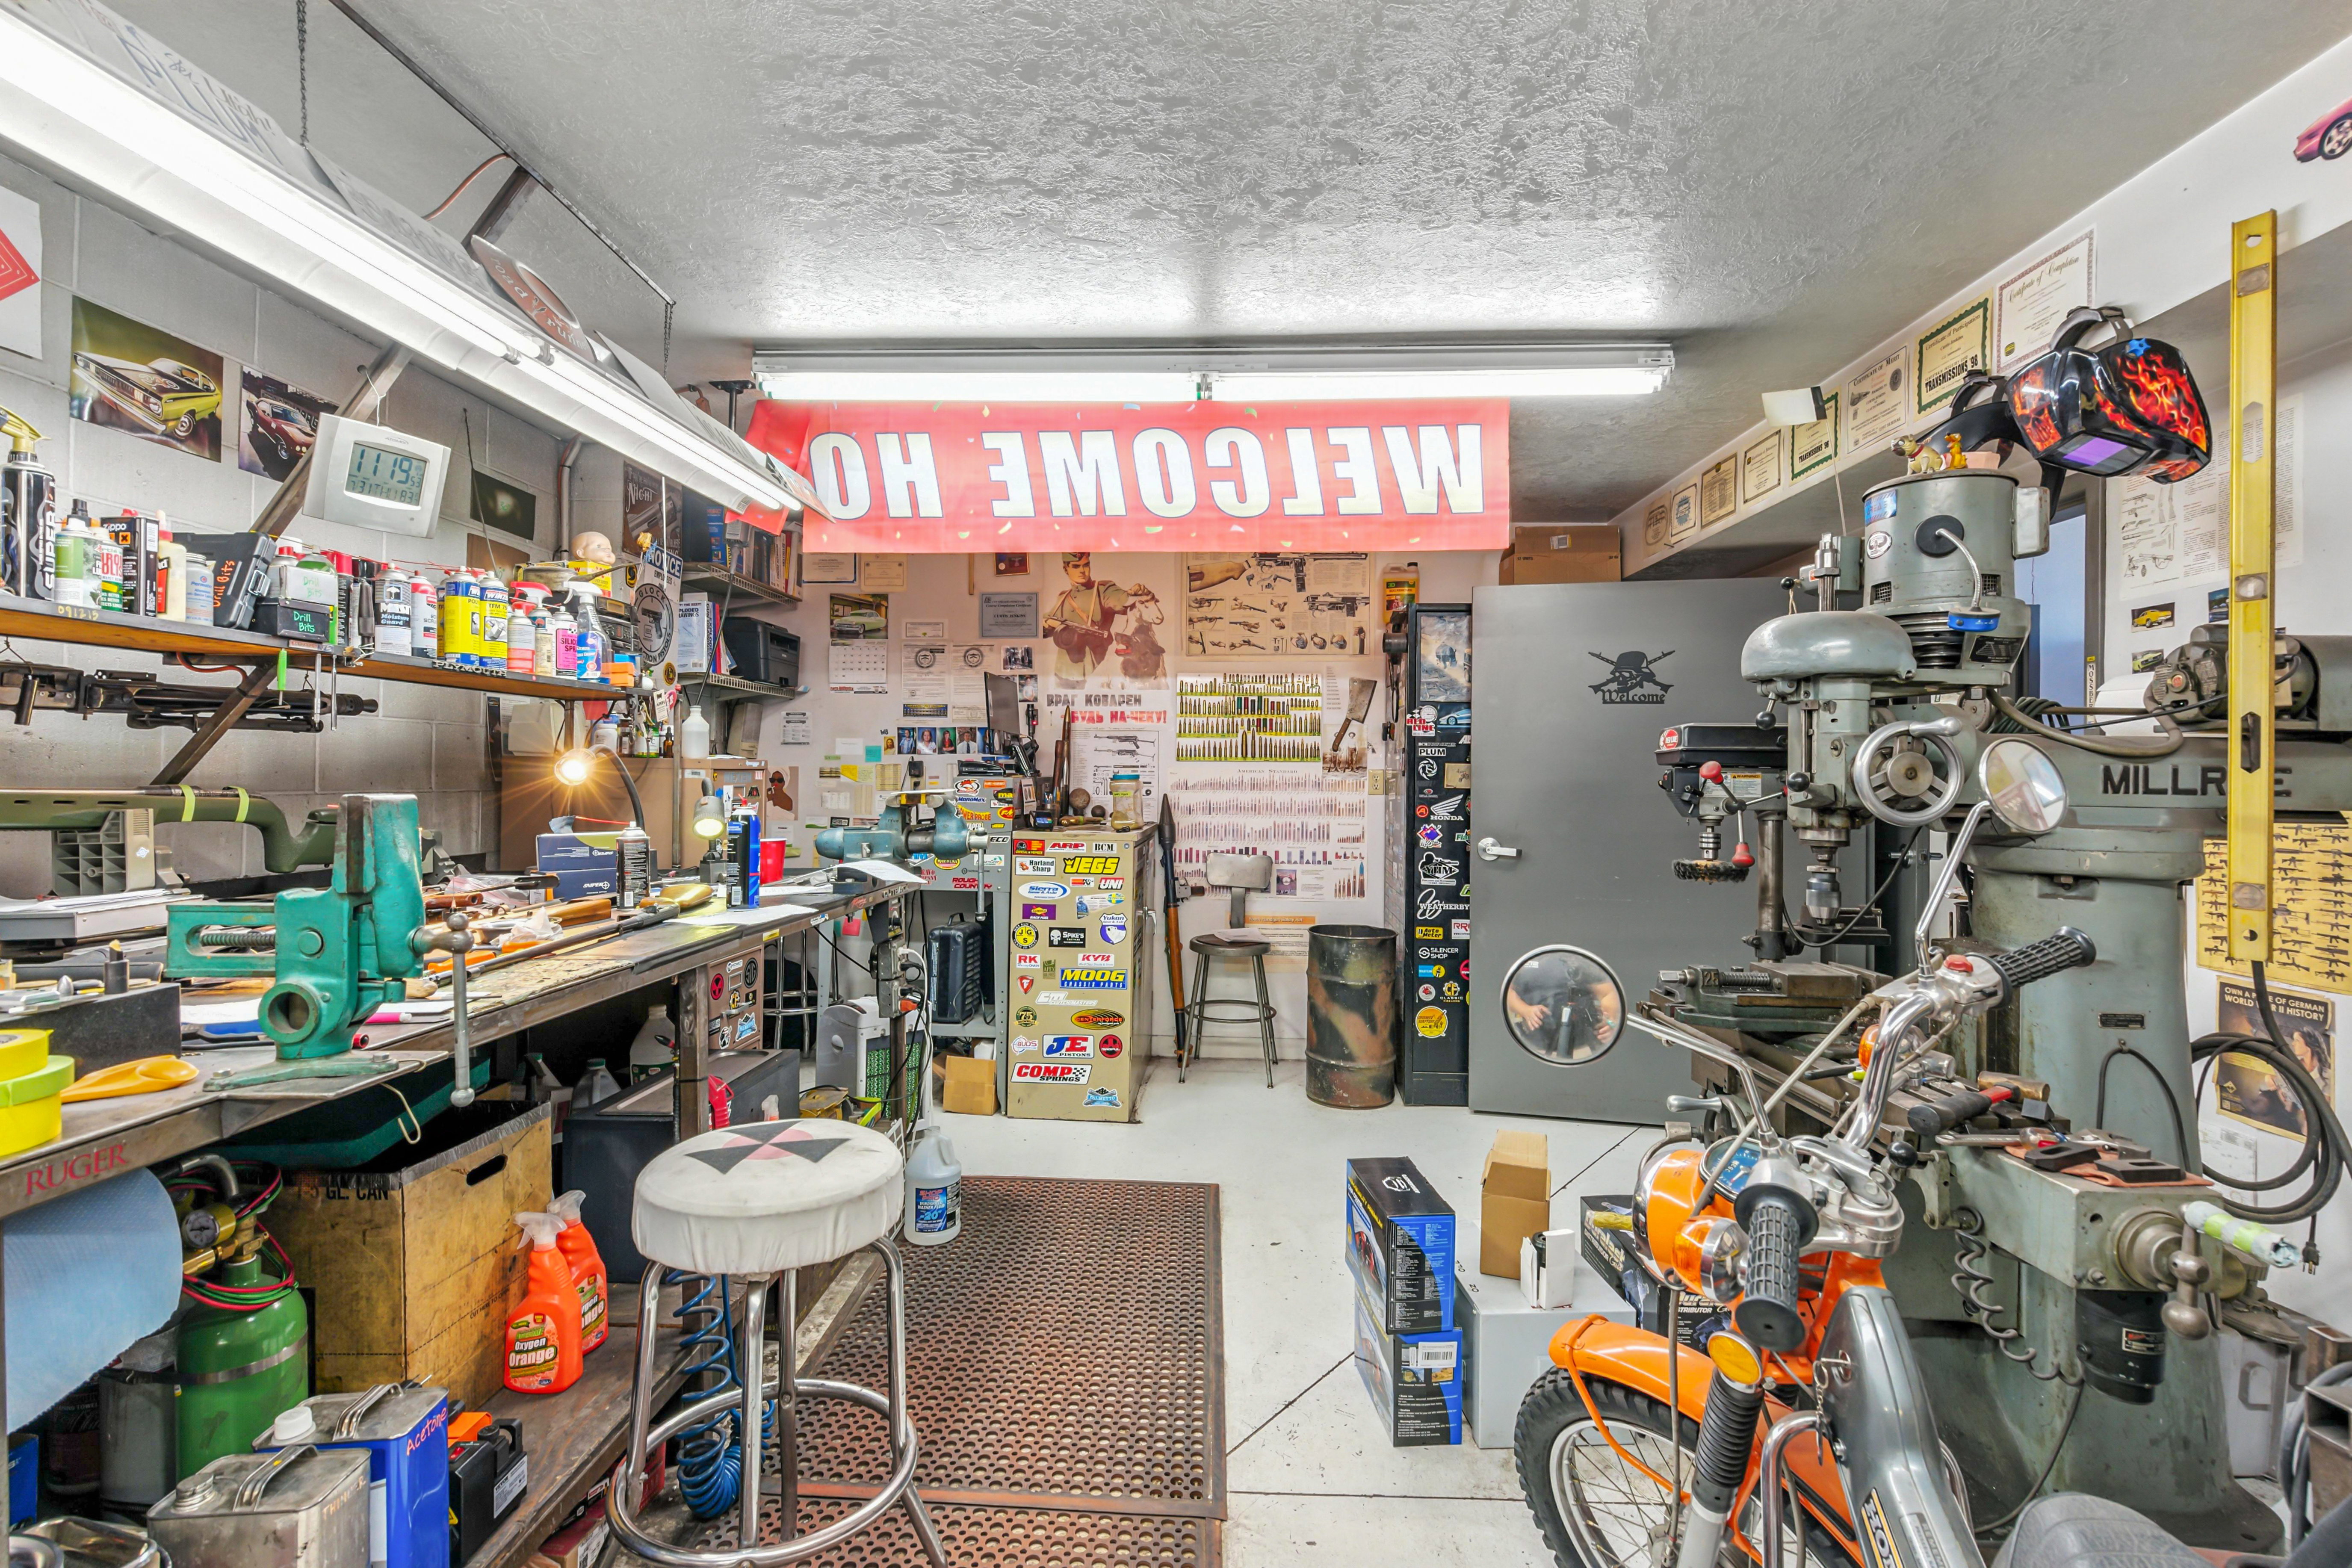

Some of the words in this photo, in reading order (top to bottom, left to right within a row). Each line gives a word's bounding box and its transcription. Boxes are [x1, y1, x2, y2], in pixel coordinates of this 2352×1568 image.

[2006, 279, 2035, 302] Certificate
[2037, 271, 2044, 286] of
[2045, 257, 2079, 277] Completion
[1925, 336, 1946, 351] Certificate
[1953, 314, 1980, 335] Participation
[1854, 367, 1878, 387] CERTIFICATE
[1885, 354, 1900, 366] MERIT
[1925, 361, 1968, 393] TRANSMISSIONS
[1969, 354, 1978, 369] '98
[1799, 444, 1823, 463] TRANSMISSIONS
[43, 511, 56, 590] SUPER
[216, 559, 235, 583] Bits
[293, 611, 311, 622] Drill
[381, 613, 410, 621] Moisture
[299, 622, 316, 633] Bits
[433, 661, 508, 677] PLYMOUTH
[1046, 694, 1078, 707] ВРАГ
[1085, 694, 1142, 707] КОВАРЕН
[1601, 688, 1666, 703] Welcome
[1110, 710, 1167, 723] НА-ЧЕКУ!
[2101, 765, 2293, 797] MILLRE
[1094, 843, 1114, 851] BCM
[1064, 856, 1120, 874] JEGS
[1425, 865, 1454, 875] YHM
[1099, 878, 1124, 889] UNI
[1018, 955, 1038, 963] RK
[745, 962, 756, 984] SIG
[1062, 969, 1126, 982] MOOG
[2225, 987, 2243, 996] OWN
[2288, 999, 2325, 1013] GERMAN
[2225, 994, 2254, 1007] WORLD
[2286, 1007, 2324, 1022] HISTORY
[1046, 1036, 1089, 1055] JE
[1016, 1065, 1073, 1078] COMP
[26, 1144, 129, 1196] RUGER
[470, 1309, 479, 1319] CUT
[479, 1302, 491, 1314] HERE
[491, 1298, 498, 1306] TO
[498, 1288, 511, 1300] OPEN
[581, 1294, 598, 1314] ygen
[515, 1337, 547, 1351] Oxygen
[508, 1347, 555, 1367] Orange
[406, 1406, 447, 1456] Acetone
[495, 1476, 509, 1491] VEVOR
[322, 1475, 366, 1520] THINNER
